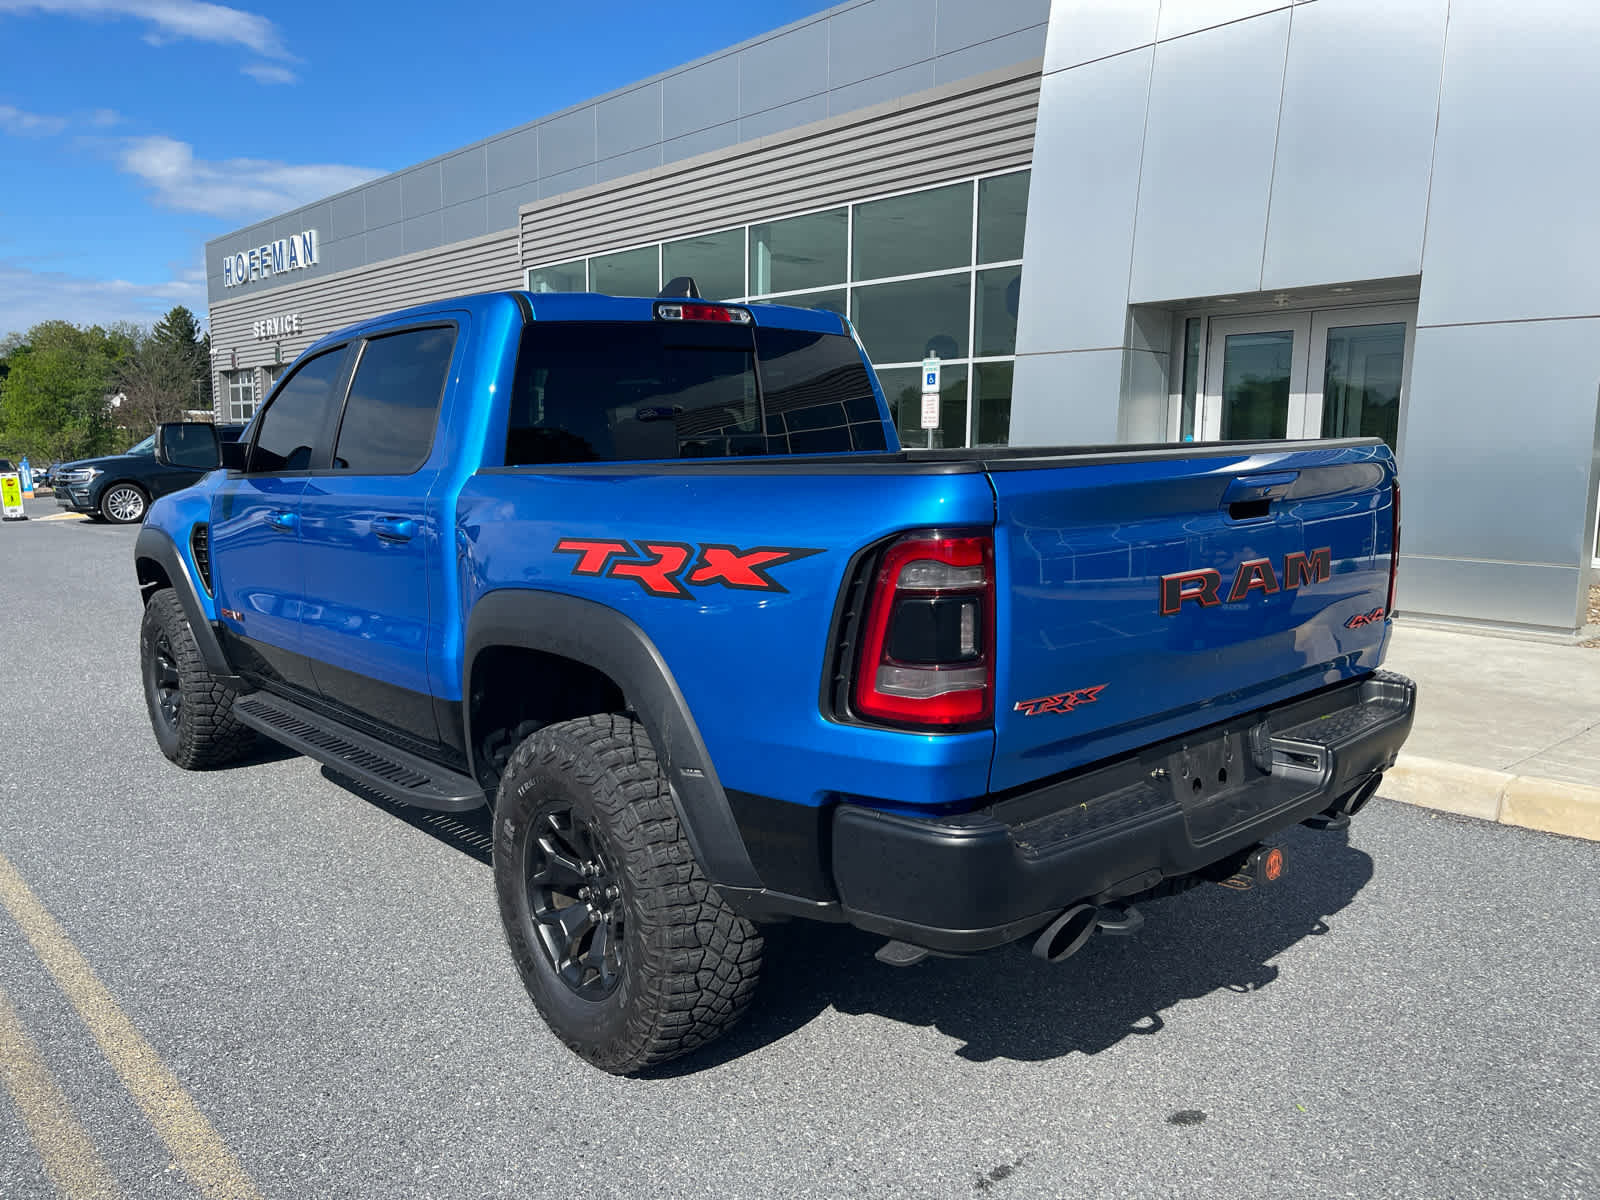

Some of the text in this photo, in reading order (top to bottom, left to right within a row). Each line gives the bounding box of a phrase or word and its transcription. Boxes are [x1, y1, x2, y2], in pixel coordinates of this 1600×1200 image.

[223, 229, 319, 288] HOFFMAN
[252, 313, 300, 338] SERVICE
[552, 537, 828, 601] TRX
[1159, 547, 1332, 617] RAM
[1013, 681, 1112, 717] TRX
